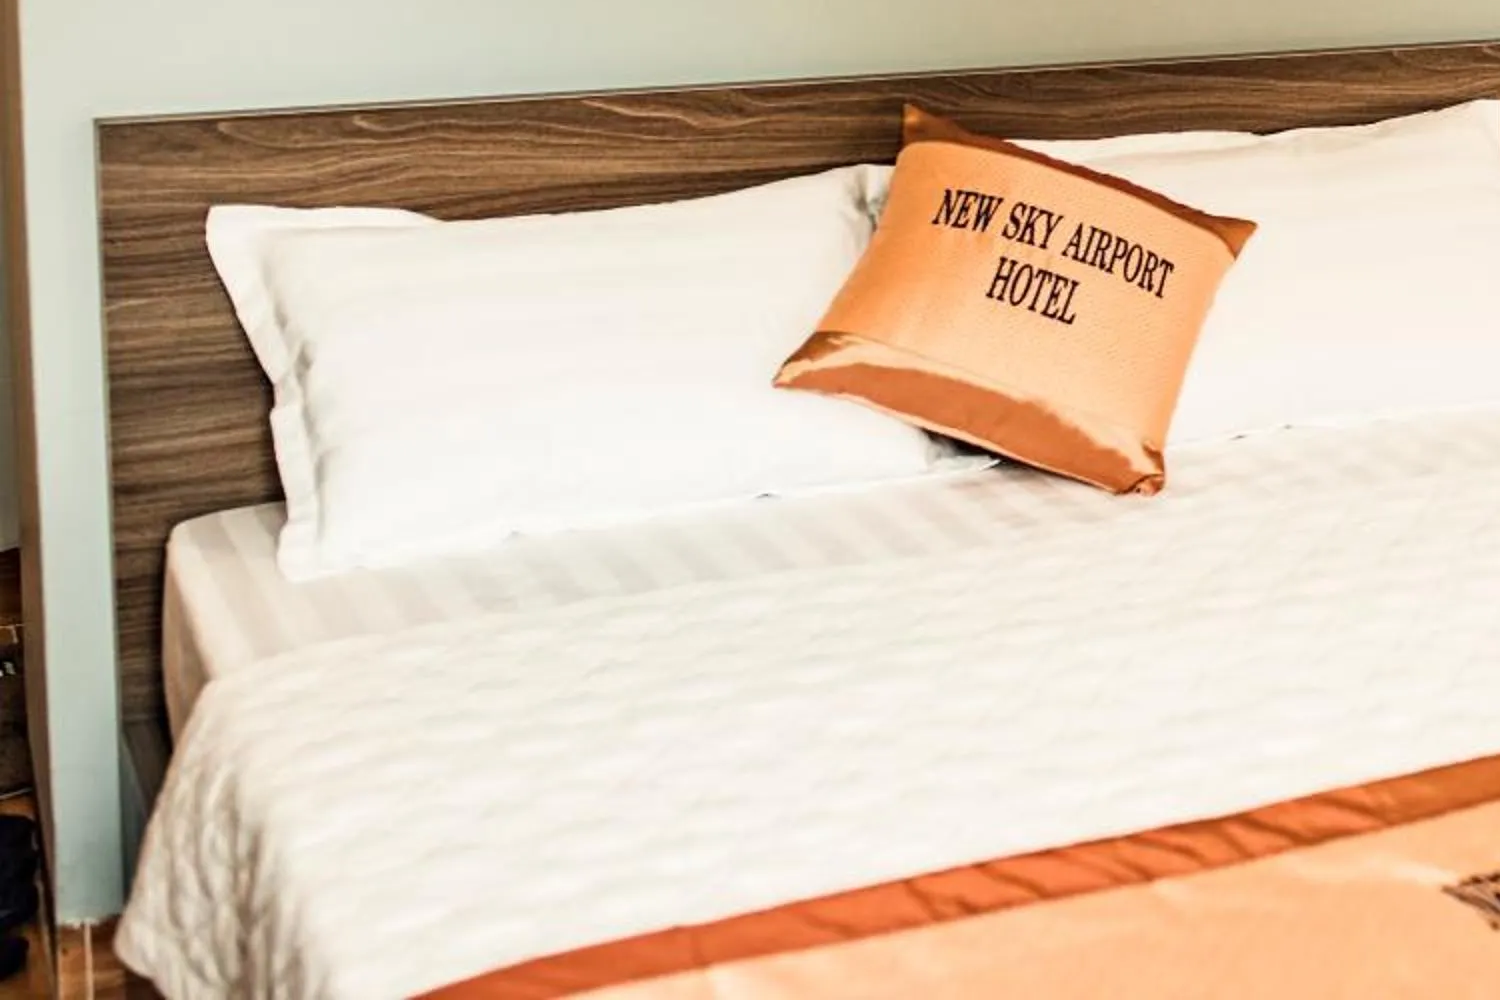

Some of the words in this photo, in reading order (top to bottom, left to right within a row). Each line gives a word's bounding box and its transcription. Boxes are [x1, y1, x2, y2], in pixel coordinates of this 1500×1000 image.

[932, 188, 1003, 233] NEW
[1001, 201, 1064, 250] SKY
[1061, 222, 1175, 299] AIRPORT
[985, 256, 1081, 325] HOTEL
